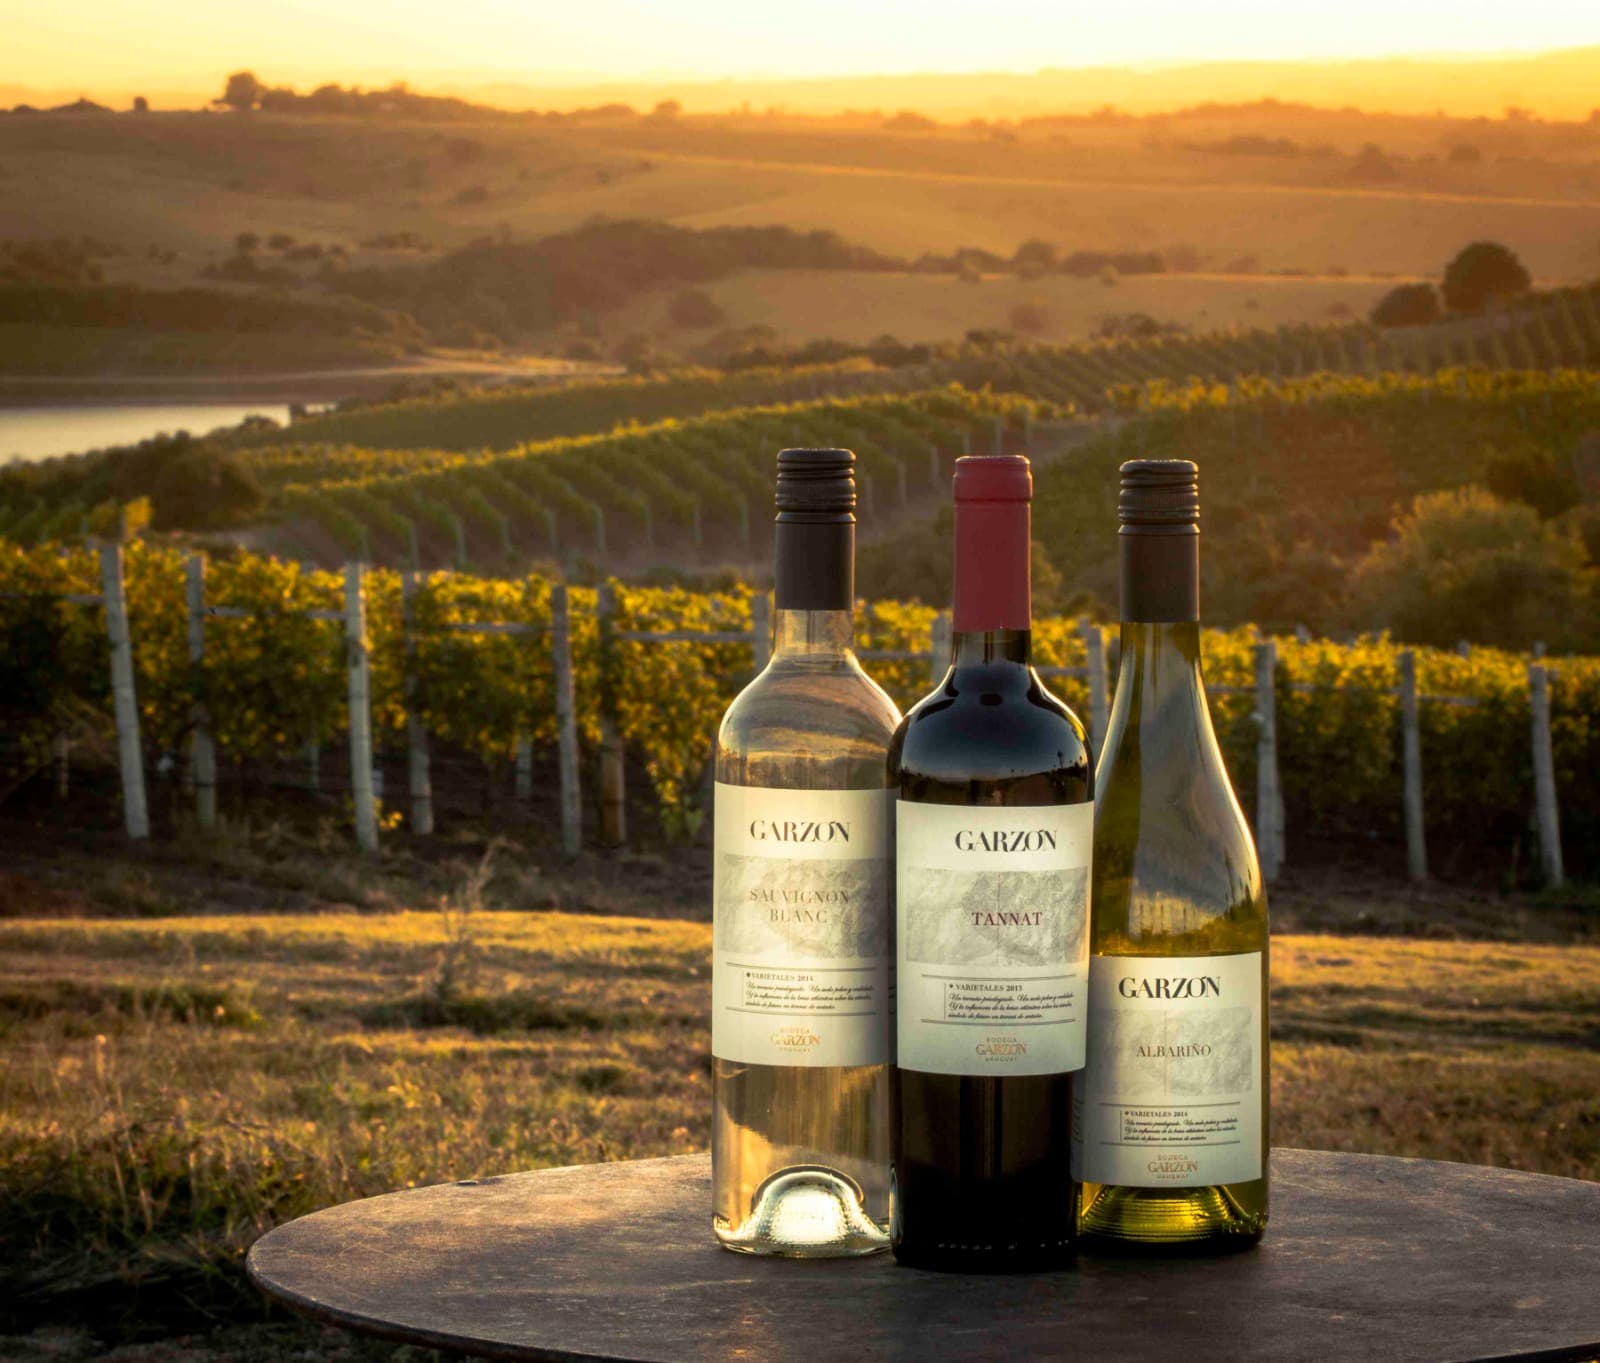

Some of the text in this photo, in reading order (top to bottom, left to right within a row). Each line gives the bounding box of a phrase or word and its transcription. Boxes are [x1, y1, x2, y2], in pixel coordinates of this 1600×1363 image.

[750, 819, 851, 843] GARZÓN
[955, 829, 1057, 852] GARZÓN
[750, 889, 850, 904] SAUVIGNON
[770, 908, 828, 923] BLANC
[971, 911, 1043, 926] TANNAT
[956, 983, 1004, 992] VARIETALES
[1118, 975, 1221, 999] GARZÓN
[1136, 1043, 1212, 1057] ALBARIÑO
